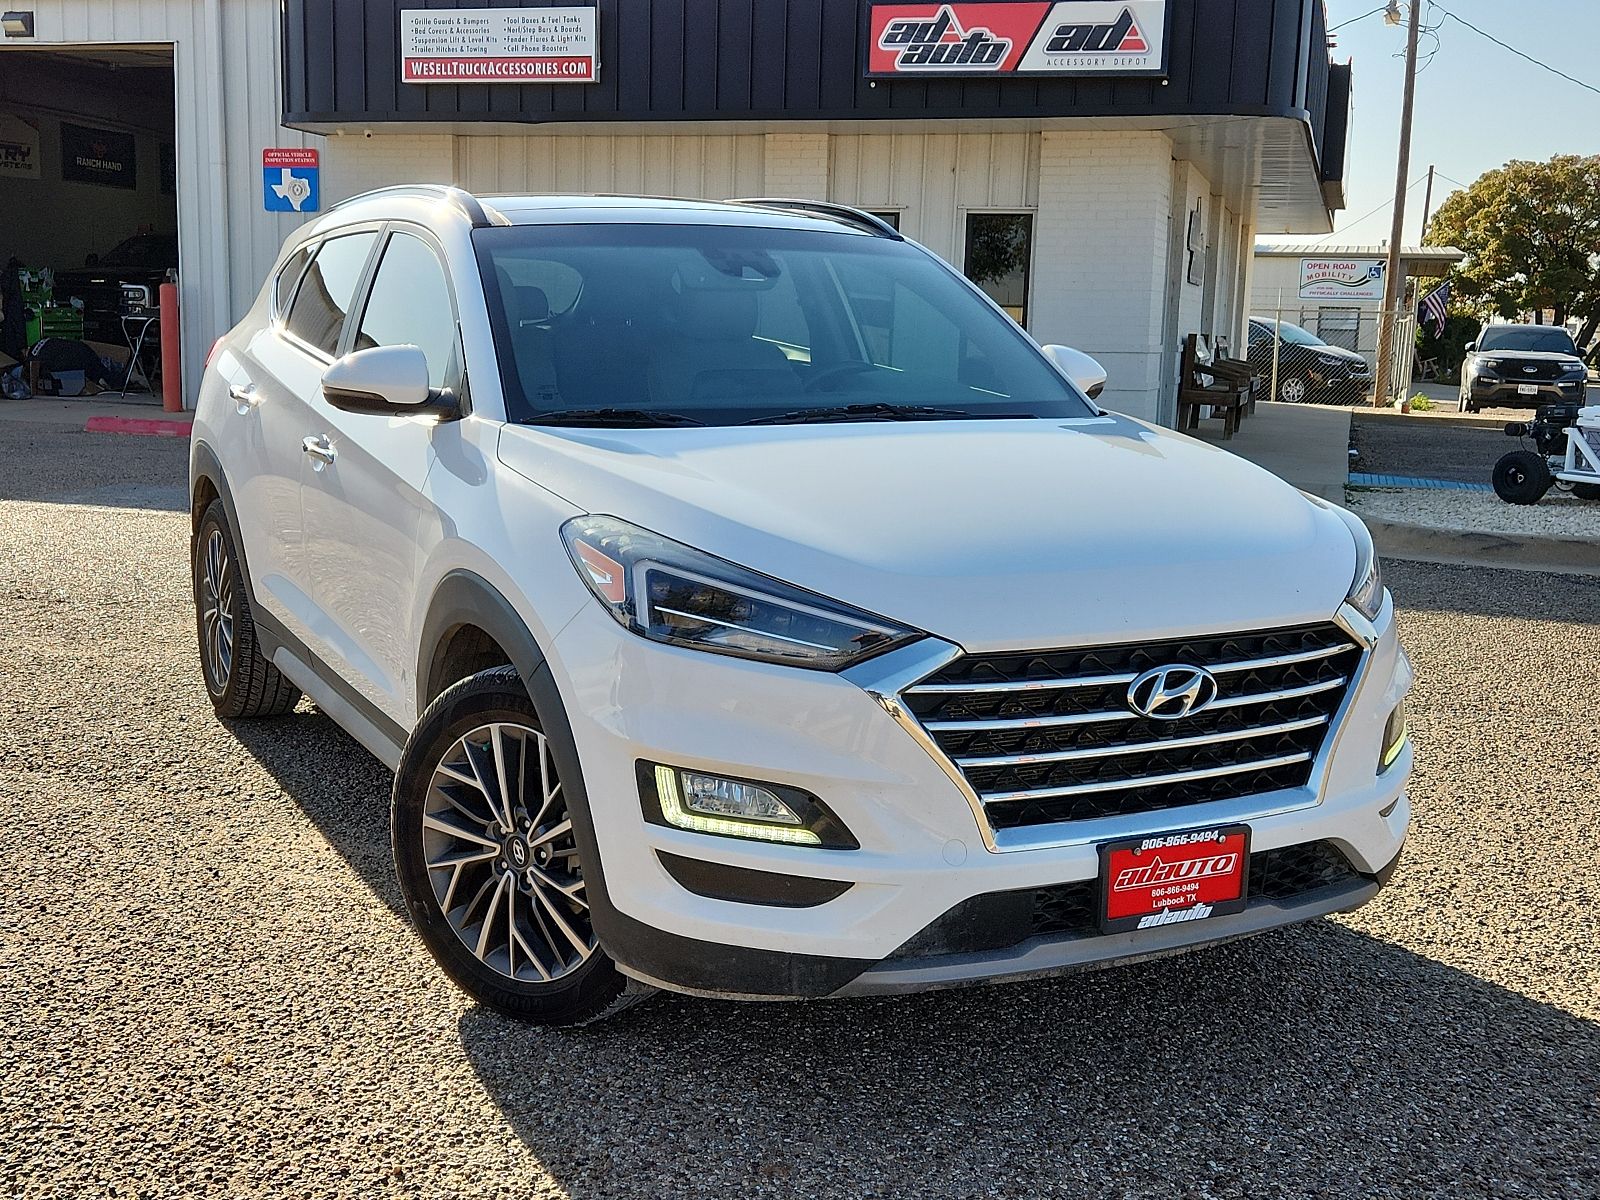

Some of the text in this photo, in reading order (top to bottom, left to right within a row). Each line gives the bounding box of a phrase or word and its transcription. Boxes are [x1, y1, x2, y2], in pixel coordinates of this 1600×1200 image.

[463, 18, 490, 26] Bumpers
[507, 16, 520, 24] Tool
[522, 16, 539, 24] Boxes
[542, 16, 546, 24] &
[548, 16, 560, 24] Fuel
[507, 26, 536, 34] Nerf/Step
[414, 37, 448, 45] Suspension
[507, 35, 528, 43] Fender
[557, 35, 573, 44] Light
[466, 46, 488, 54] Towing
[1046, 57, 1148, 66] ACCESSORY DEPOT
[77, 156, 101, 169] RANCH
[102, 160, 122, 172] HAND
[1306, 272, 1354, 280] MOBILITY
[1140, 829, 1219, 851] 806-866-9494
[1151, 882, 1200, 898] 806-866-9494
[1152, 893, 1197, 909] Lubbock TX
